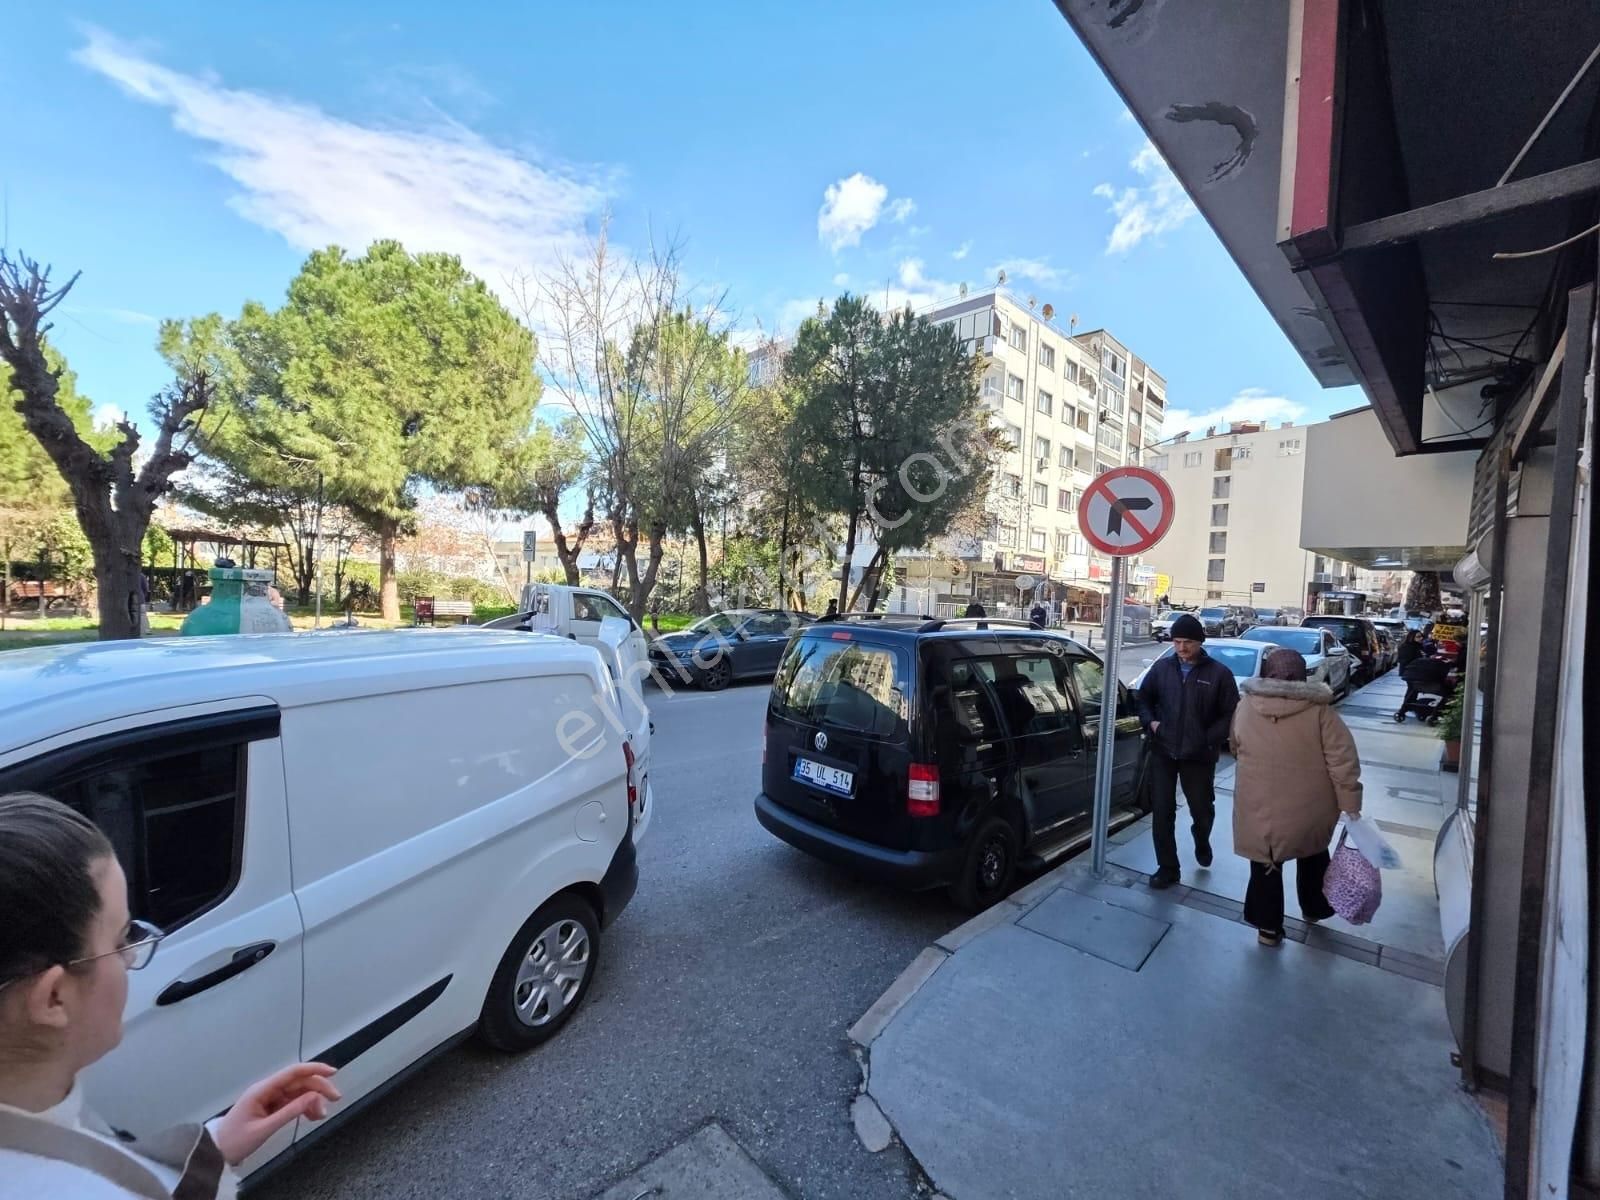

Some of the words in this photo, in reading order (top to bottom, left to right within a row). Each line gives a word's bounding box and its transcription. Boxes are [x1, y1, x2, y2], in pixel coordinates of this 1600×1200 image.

[801, 761, 811, 775] 35
[816, 765, 826, 781] UL
[832, 770, 849, 788] 514
